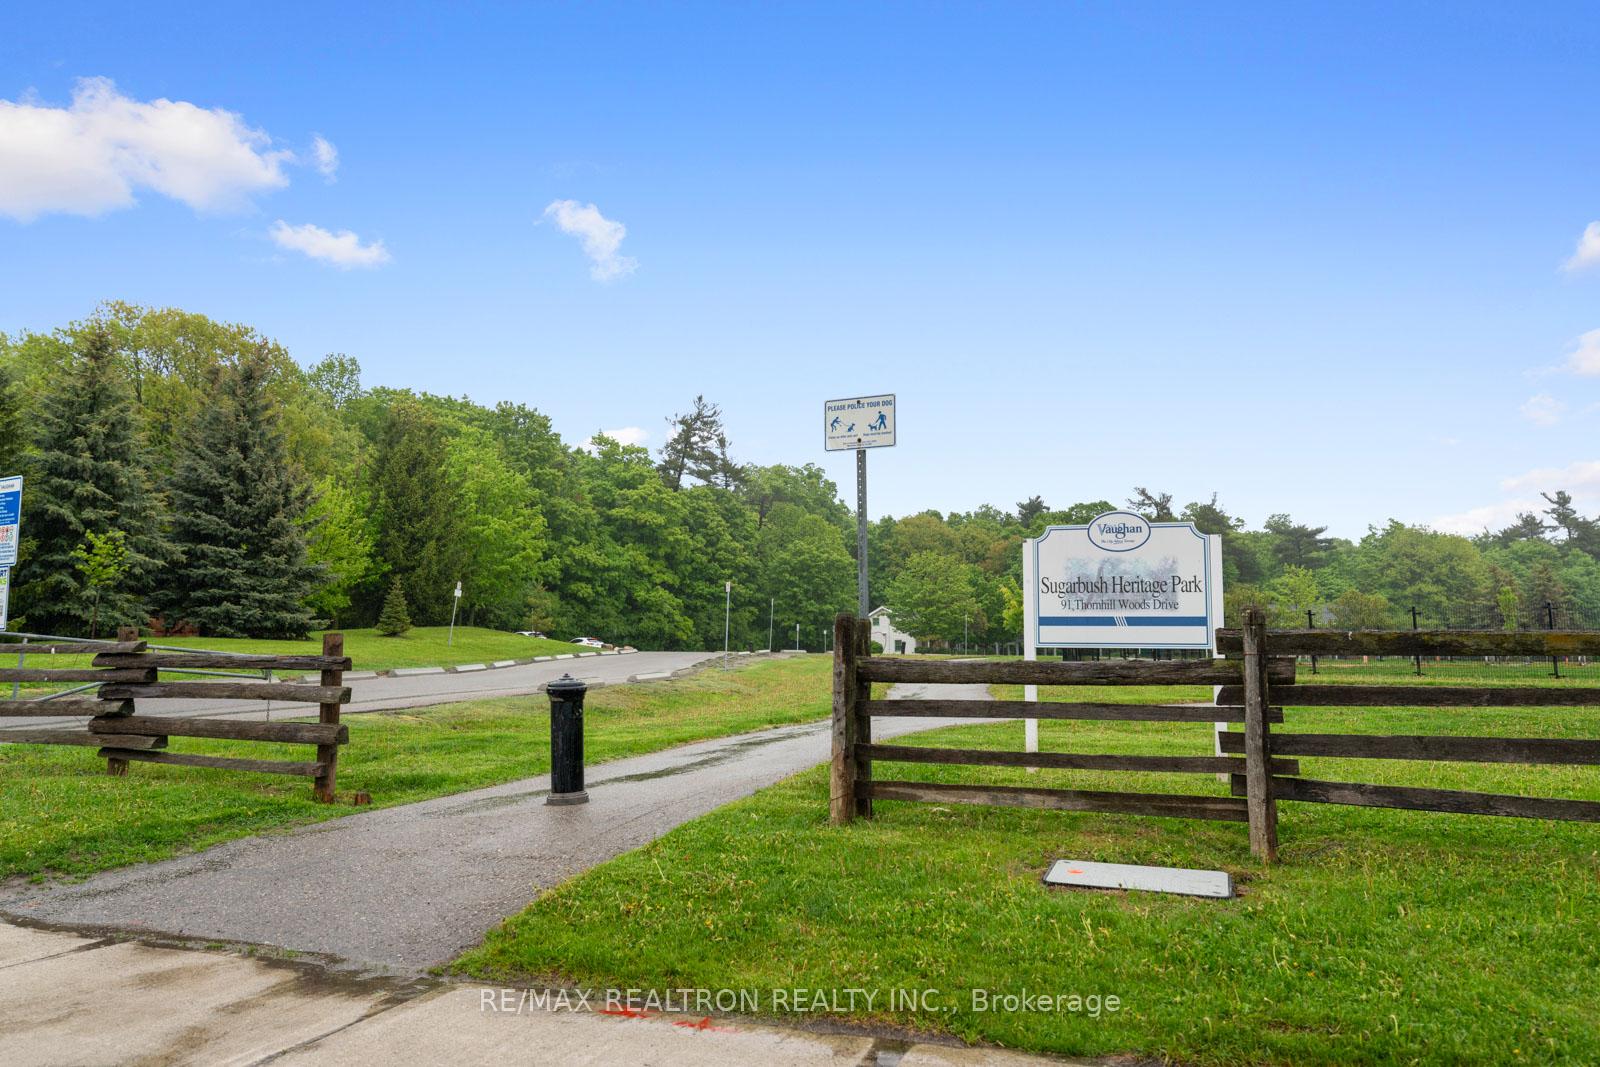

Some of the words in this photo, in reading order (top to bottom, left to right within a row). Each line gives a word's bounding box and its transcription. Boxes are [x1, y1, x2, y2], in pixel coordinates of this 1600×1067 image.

[1096, 522, 1142, 539] Vaughan
[1041, 576, 1108, 599] Sugarbush
[1112, 576, 1168, 597] Heritage
[1171, 575, 1203, 593] Park
[1075, 599, 1115, 610] Thornhill
[1118, 599, 1150, 610] Woods
[1153, 599, 1179, 610] Drive
